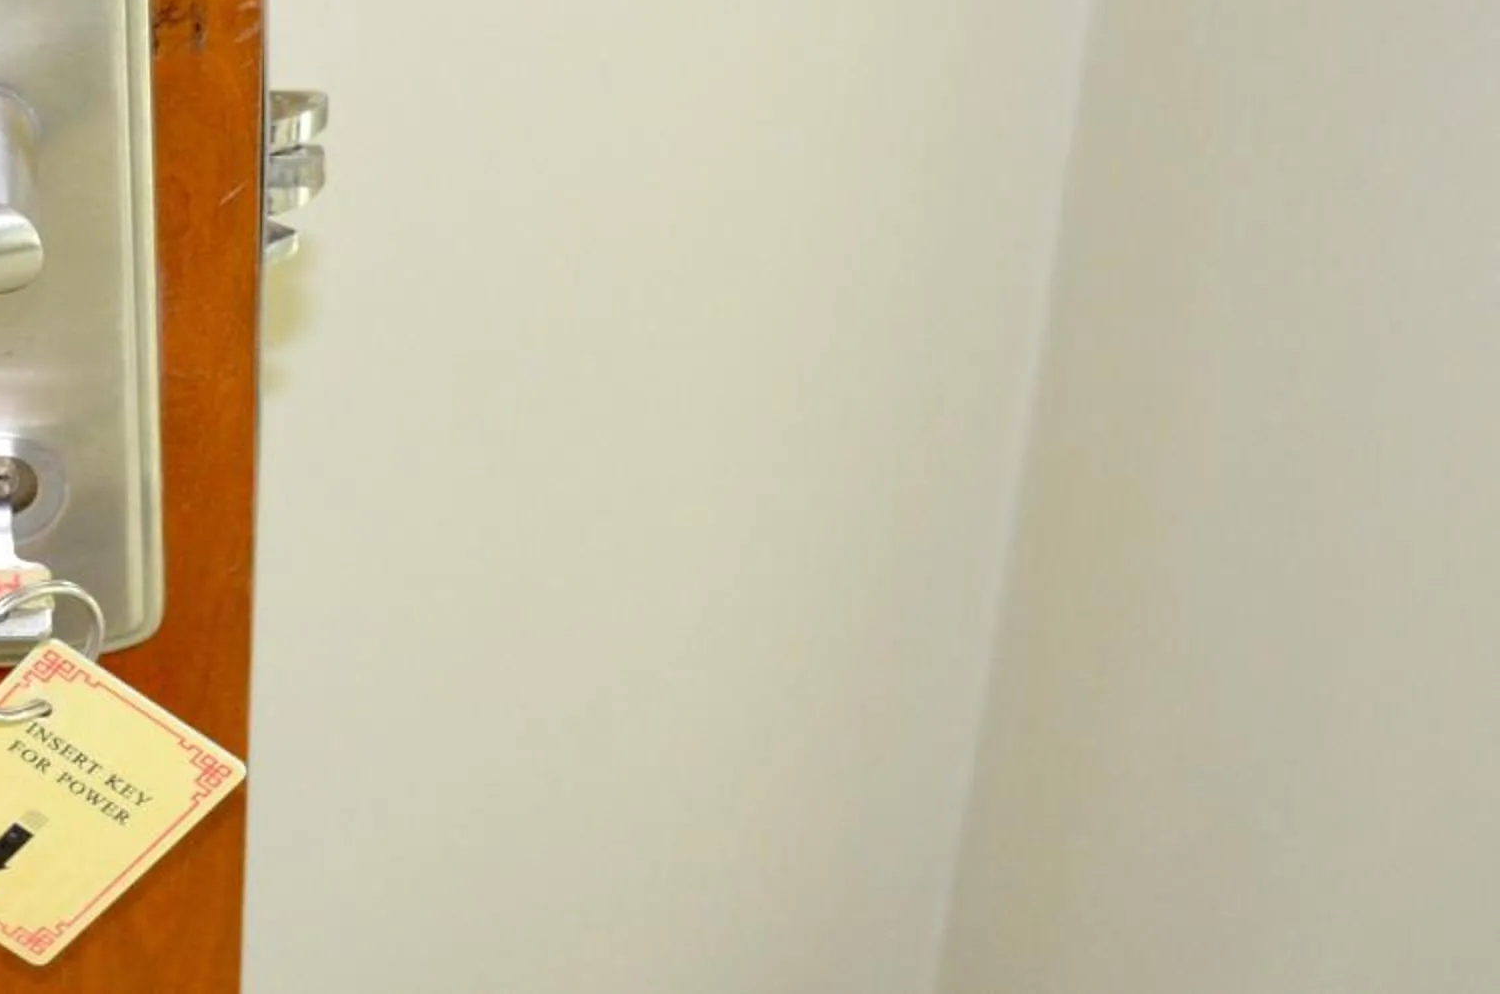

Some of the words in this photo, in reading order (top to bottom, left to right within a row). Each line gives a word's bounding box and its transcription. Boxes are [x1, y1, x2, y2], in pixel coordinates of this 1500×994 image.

[7, 740, 52, 774] FOR
[56, 772, 130, 825] POWER
[25, 722, 103, 775] INSERT
[104, 774, 153, 807] KEY
